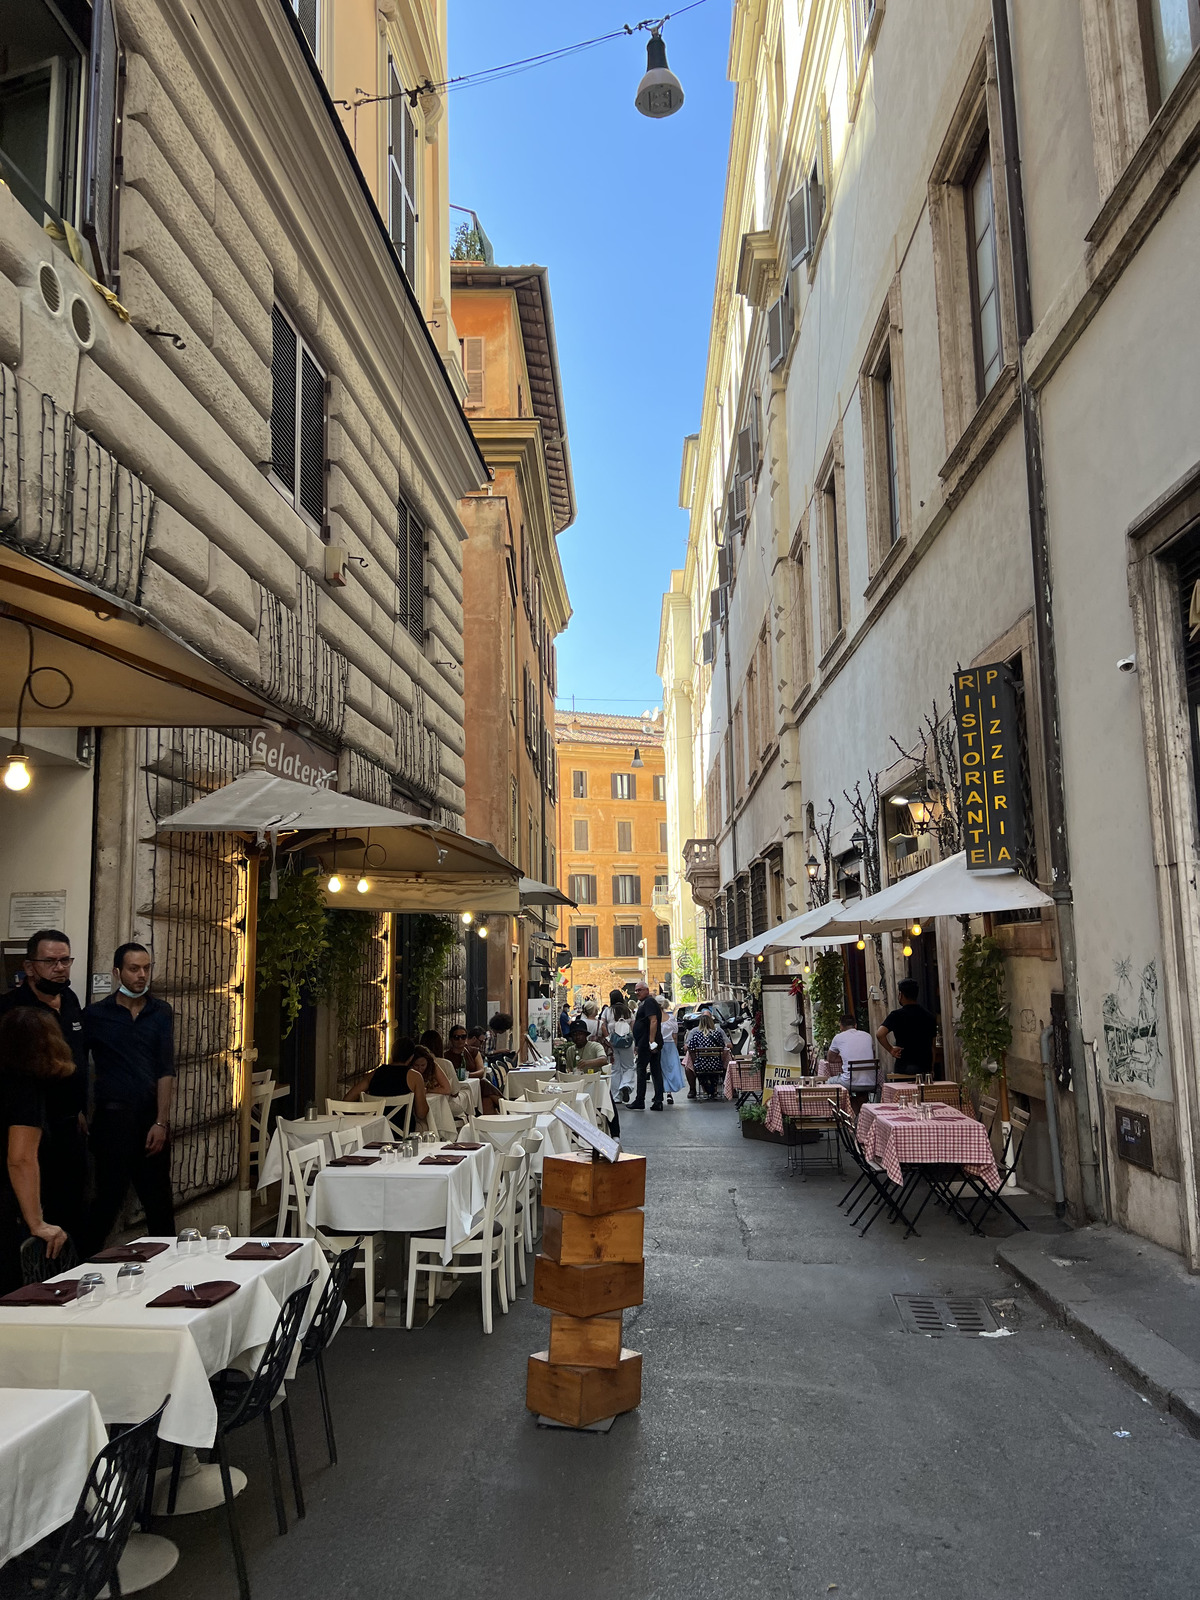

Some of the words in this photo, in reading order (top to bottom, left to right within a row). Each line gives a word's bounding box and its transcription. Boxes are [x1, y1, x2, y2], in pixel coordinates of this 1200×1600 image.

[958, 675, 986, 864] RISTORANTE
[986, 670, 1012, 861] PIZZERIA
[774, 1067, 791, 1078] PIZZA
